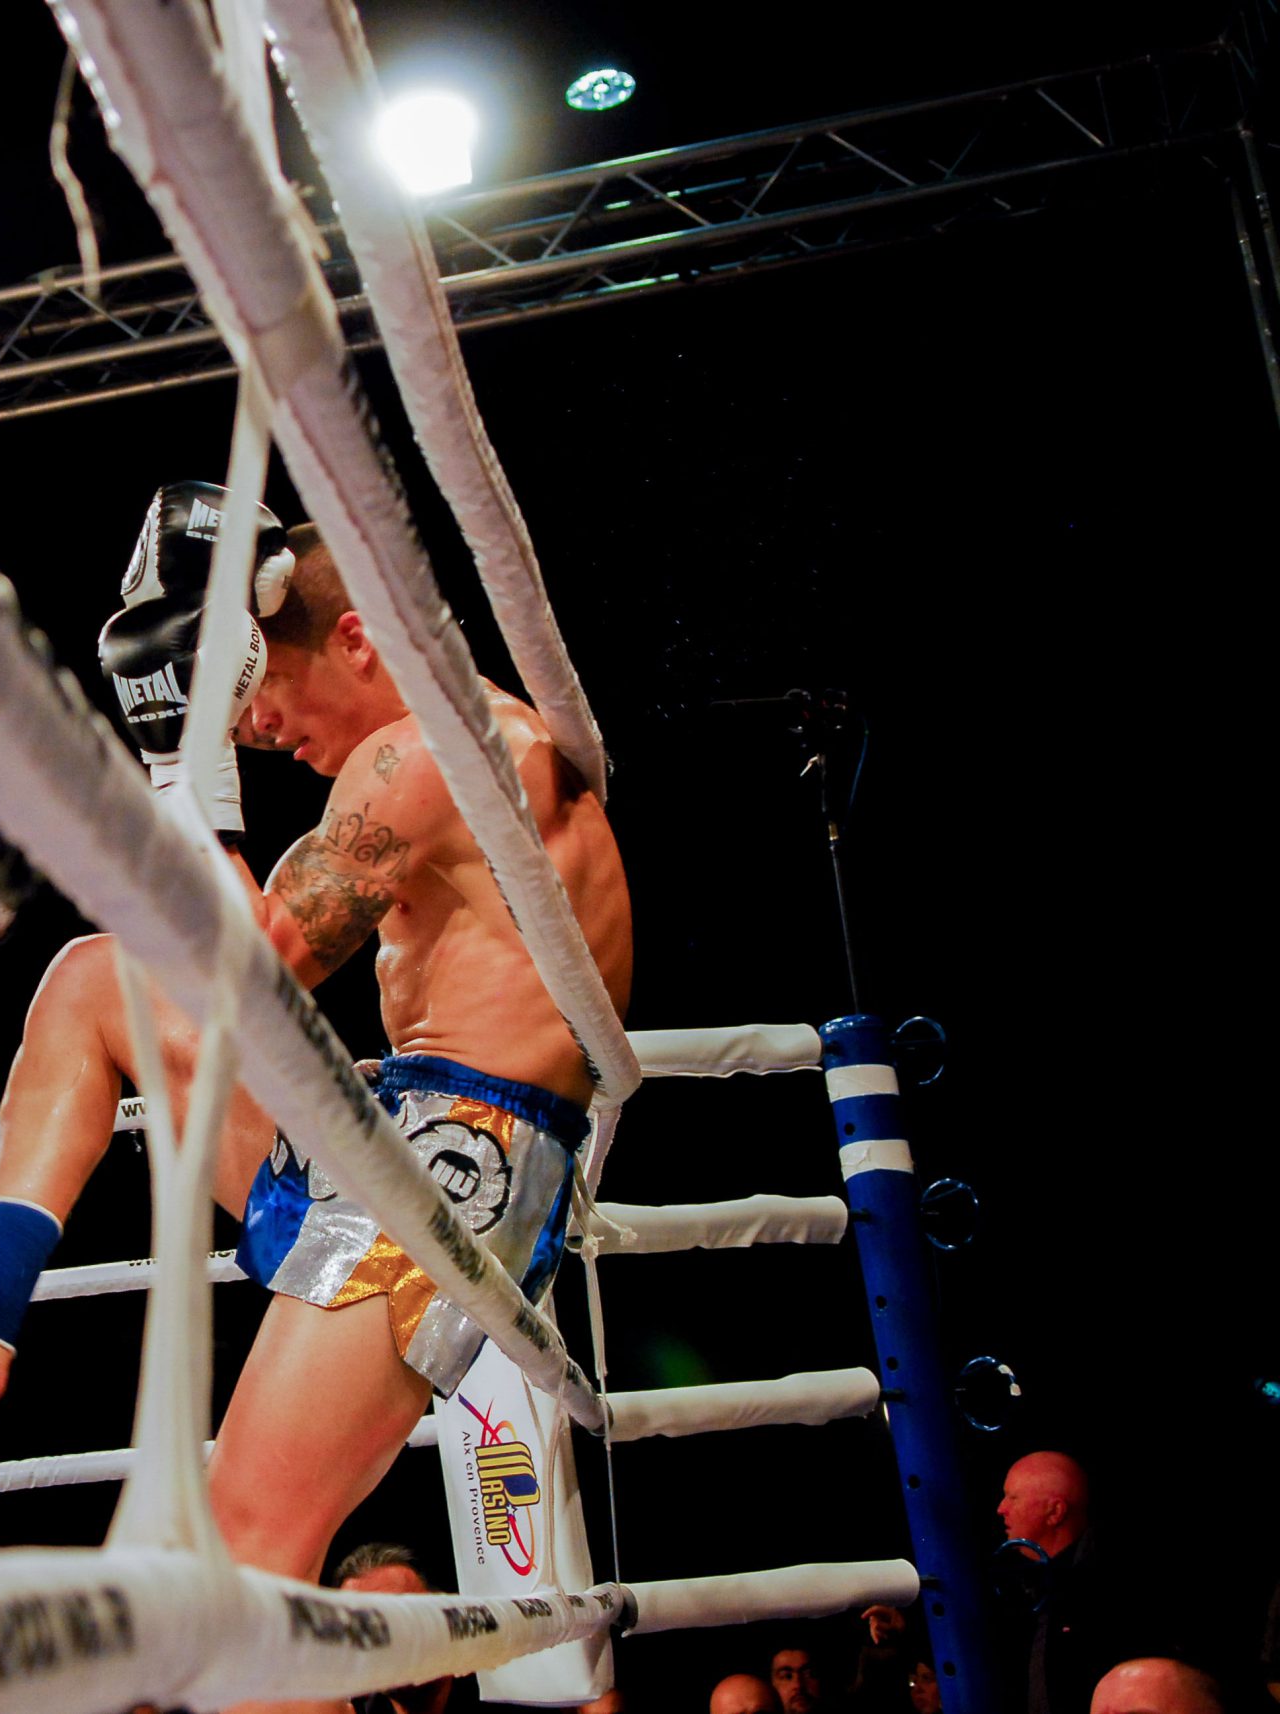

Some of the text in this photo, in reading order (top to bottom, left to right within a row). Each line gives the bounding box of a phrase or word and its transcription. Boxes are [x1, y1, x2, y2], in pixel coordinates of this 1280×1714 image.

[112, 661, 190, 717] METAL
[233, 657, 258, 700] METAL
[462, 1431, 485, 1565] Aix en Provence
